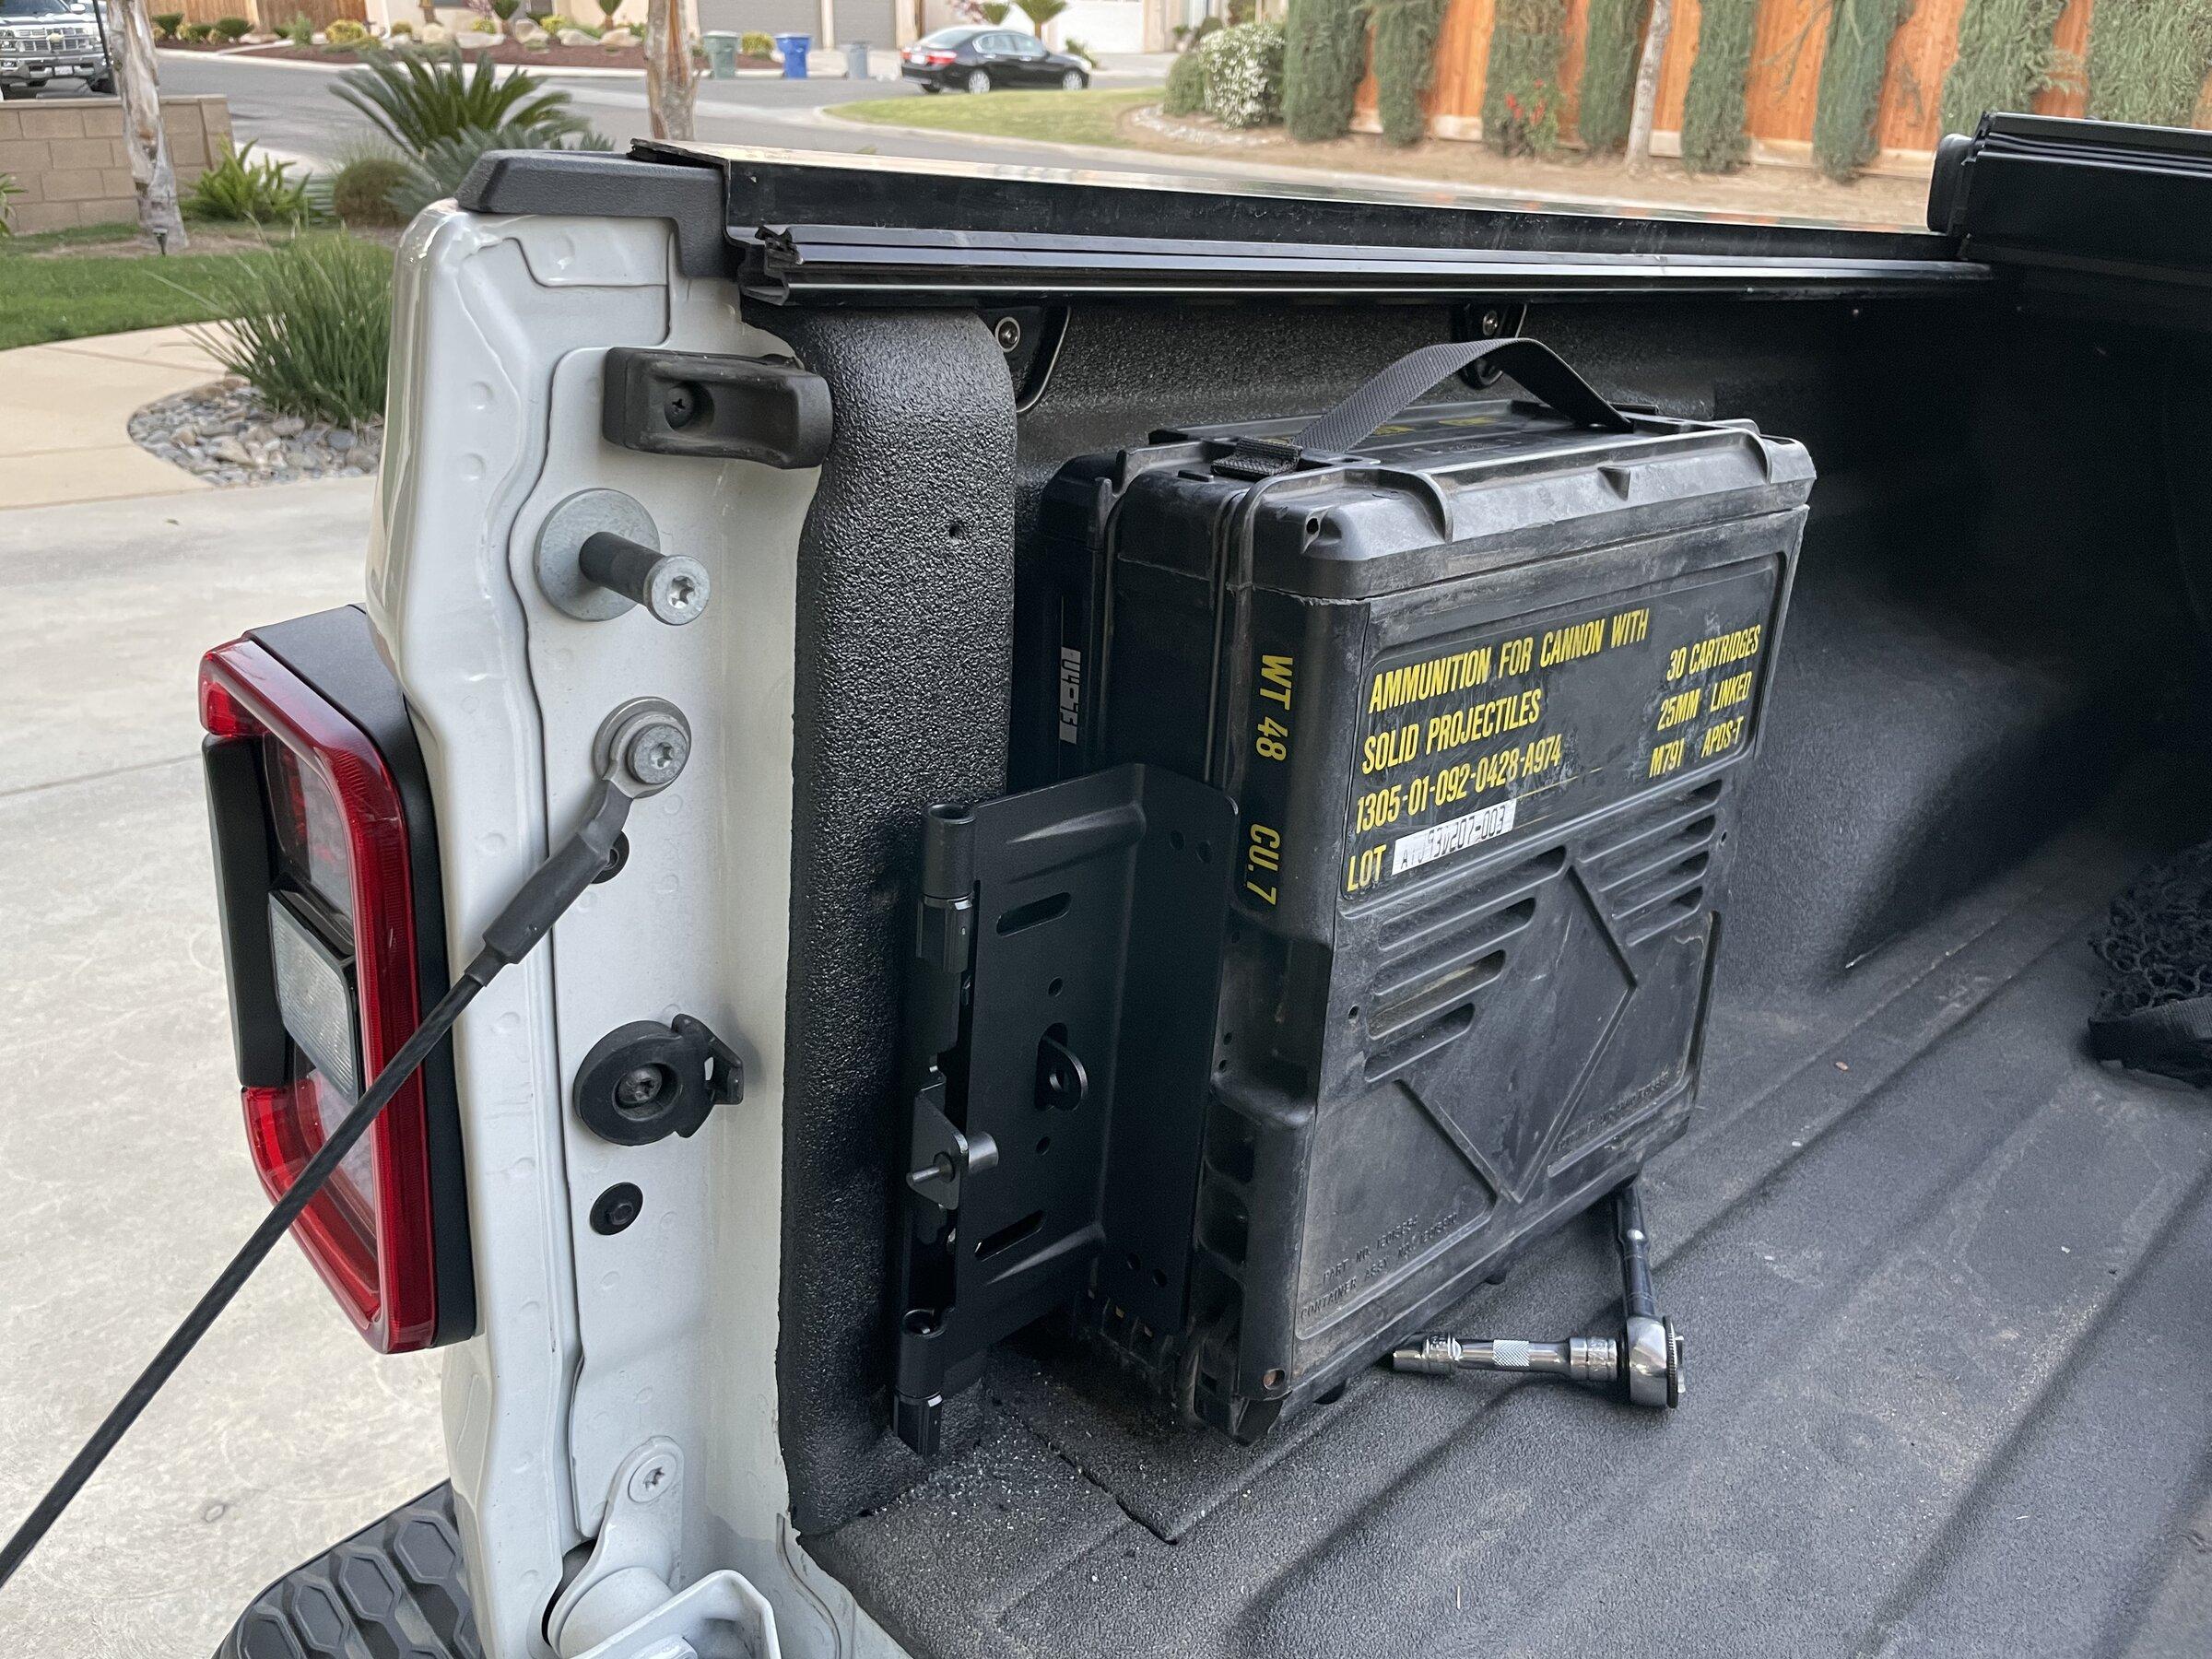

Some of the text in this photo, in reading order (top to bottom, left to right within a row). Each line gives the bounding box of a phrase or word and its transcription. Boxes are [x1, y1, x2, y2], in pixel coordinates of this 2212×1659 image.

[1369, 607, 1650, 713] AMMUNITION FOR CANNON WITH
[1666, 624, 1761, 681] 30 CARTRIDGES
[1255, 654, 1294, 761] WT 48
[1361, 688, 1542, 774] SOLID PROJECTILES
[1657, 671, 1753, 731] 25MM LINKED
[1356, 734, 1562, 833] 1305-01-092-0428-A974
[1649, 738, 1685, 778] M791
[1246, 879, 1277, 906] 7
[1347, 844, 1386, 892] LOT
